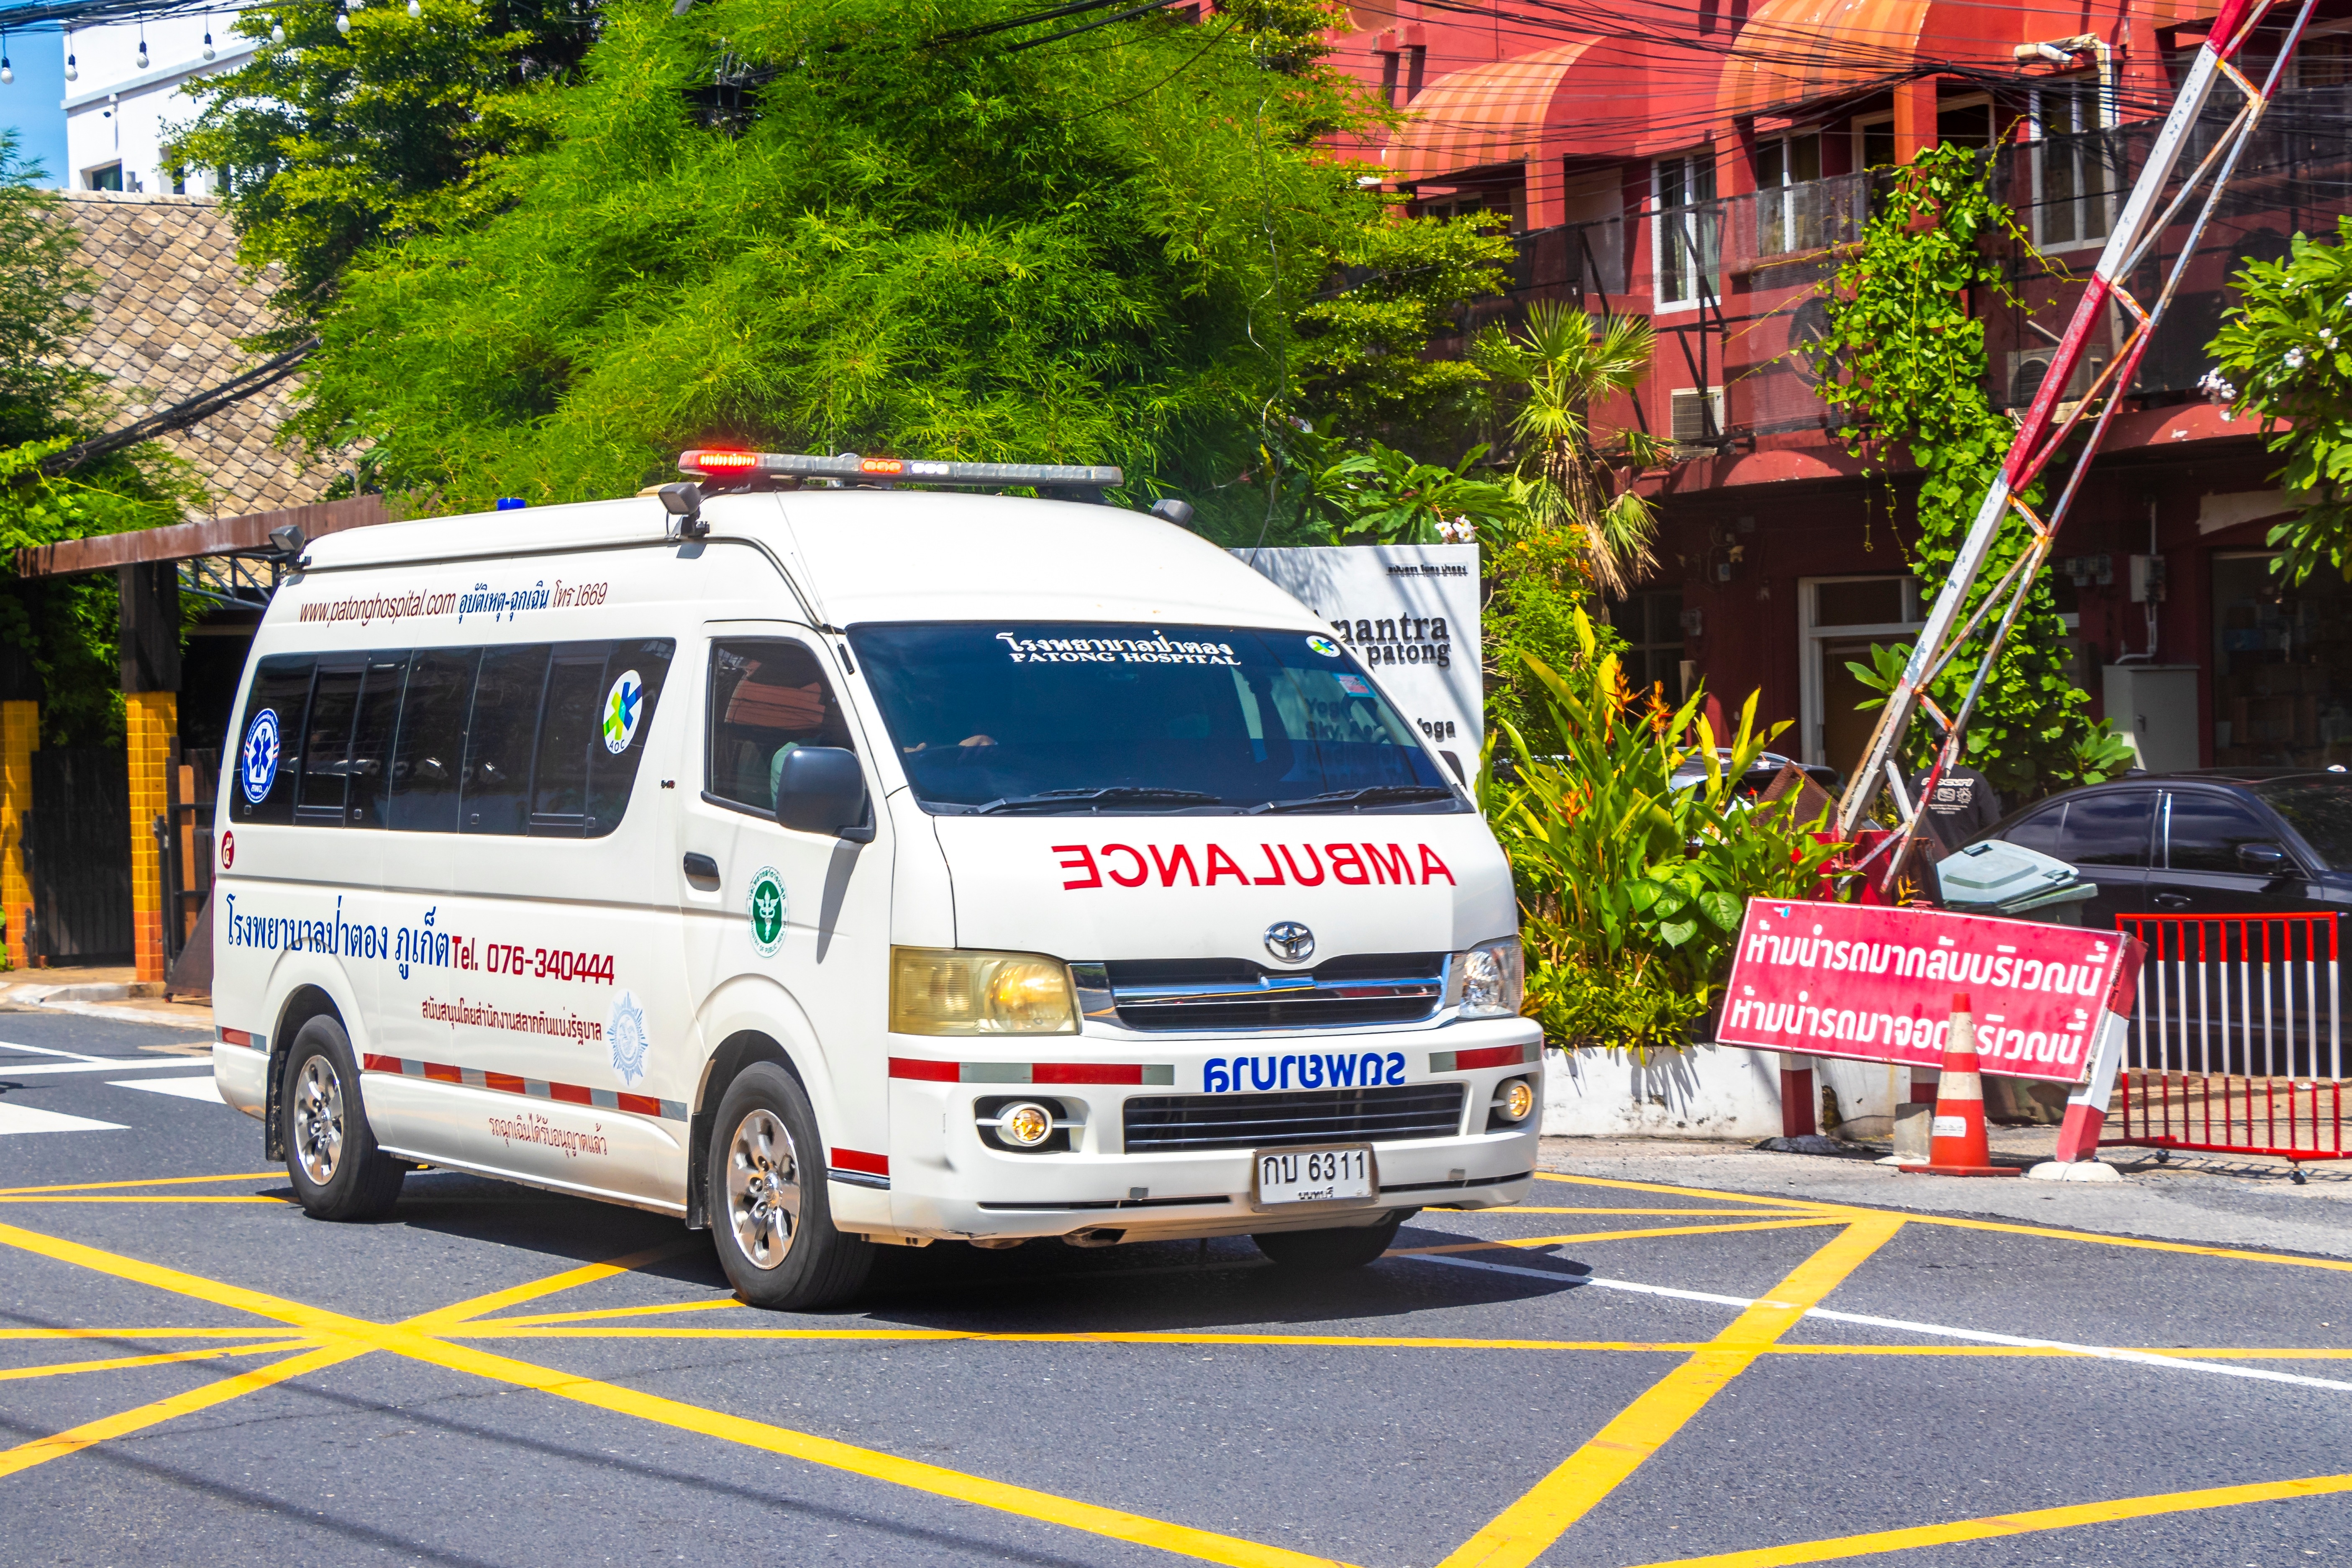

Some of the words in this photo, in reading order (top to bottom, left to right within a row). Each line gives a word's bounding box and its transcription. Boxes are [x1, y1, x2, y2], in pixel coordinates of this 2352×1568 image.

[300, 589, 456, 628] www.patonghospital.com
[459, 580, 550, 624] อุบัติเหตุ-ฉุกเฉิน
[553, 579, 575, 607] โทร
[574, 582, 608, 607] 1669
[996, 630, 1234, 655] โรงพยาบาลป่าตอง
[1314, 610, 1449, 643] nantra
[1009, 652, 1116, 663] PATONG
[1120, 652, 1242, 665] HOSPITAL
[1367, 642, 1450, 670] patong
[609, 739, 625, 752] AOC
[226, 894, 388, 960] โรงพยาบาลป่าตอง
[395, 906, 449, 980] ภูเก็ต
[452, 935, 479, 971] Tel.
[487, 943, 615, 986] 076-340444
[1745, 920, 2109, 997] ห้ามนำรถมากลับบริเวณนี้
[1729, 985, 2089, 1065] ห้ามนำรถมาจอดริเวณนี้
[489, 1112, 607, 1158] รถฉุกเฉินได้รับอนุญาตแล้ว
[1309, 1151, 1364, 1182] 6311
